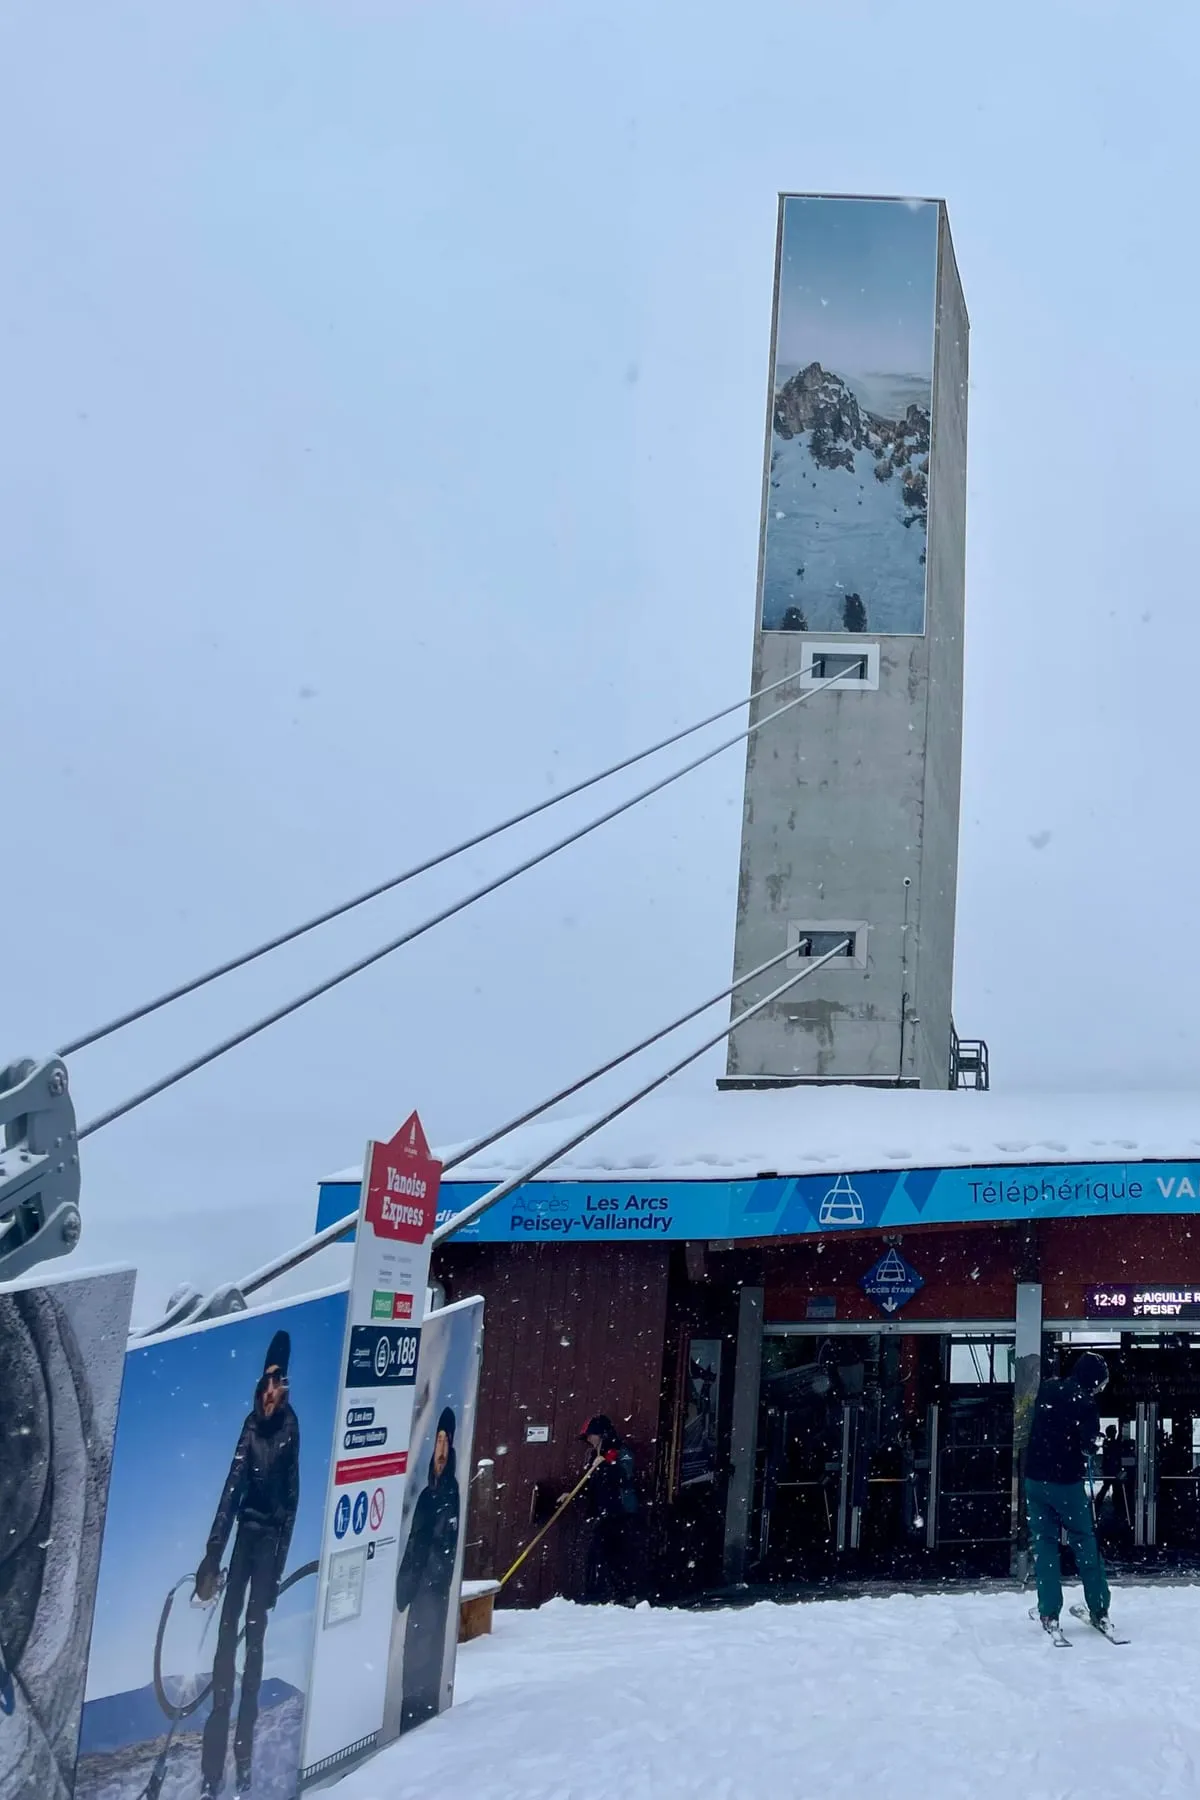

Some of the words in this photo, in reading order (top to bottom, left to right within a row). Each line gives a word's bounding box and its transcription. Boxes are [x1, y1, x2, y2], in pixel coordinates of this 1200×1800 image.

[387, 1167, 426, 1199] Vanoise
[968, 1178, 1144, 1205] Téléphérique
[586, 1195, 618, 1211] Les
[624, 1195, 668, 1210] Arcs
[381, 1196, 424, 1229] Express
[510, 1213, 673, 1233] Peisey-Vallandry
[1094, 1294, 1126, 1306] 12:49
[1144, 1292, 1192, 1303] AIGUILLE
[1143, 1305, 1182, 1315] PEISEY
